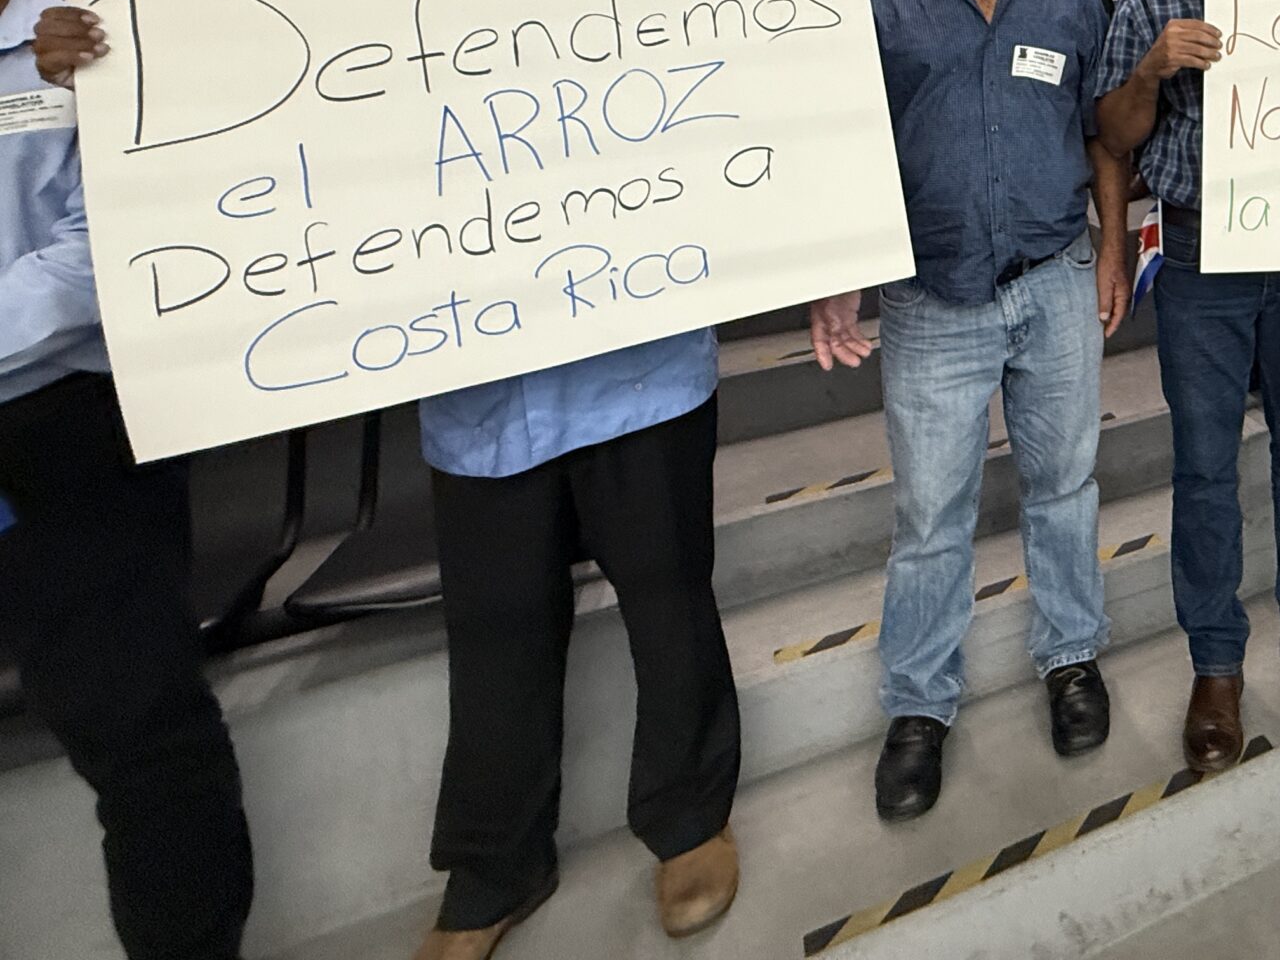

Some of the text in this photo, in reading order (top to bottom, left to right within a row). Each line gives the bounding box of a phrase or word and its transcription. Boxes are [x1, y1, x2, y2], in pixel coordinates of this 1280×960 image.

[217, 60, 740, 218] el ARROZ
[1224, 177, 1269, 232] la
[128, 146, 774, 317] Defendemos a
[244, 243, 710, 392] Costa Rica
